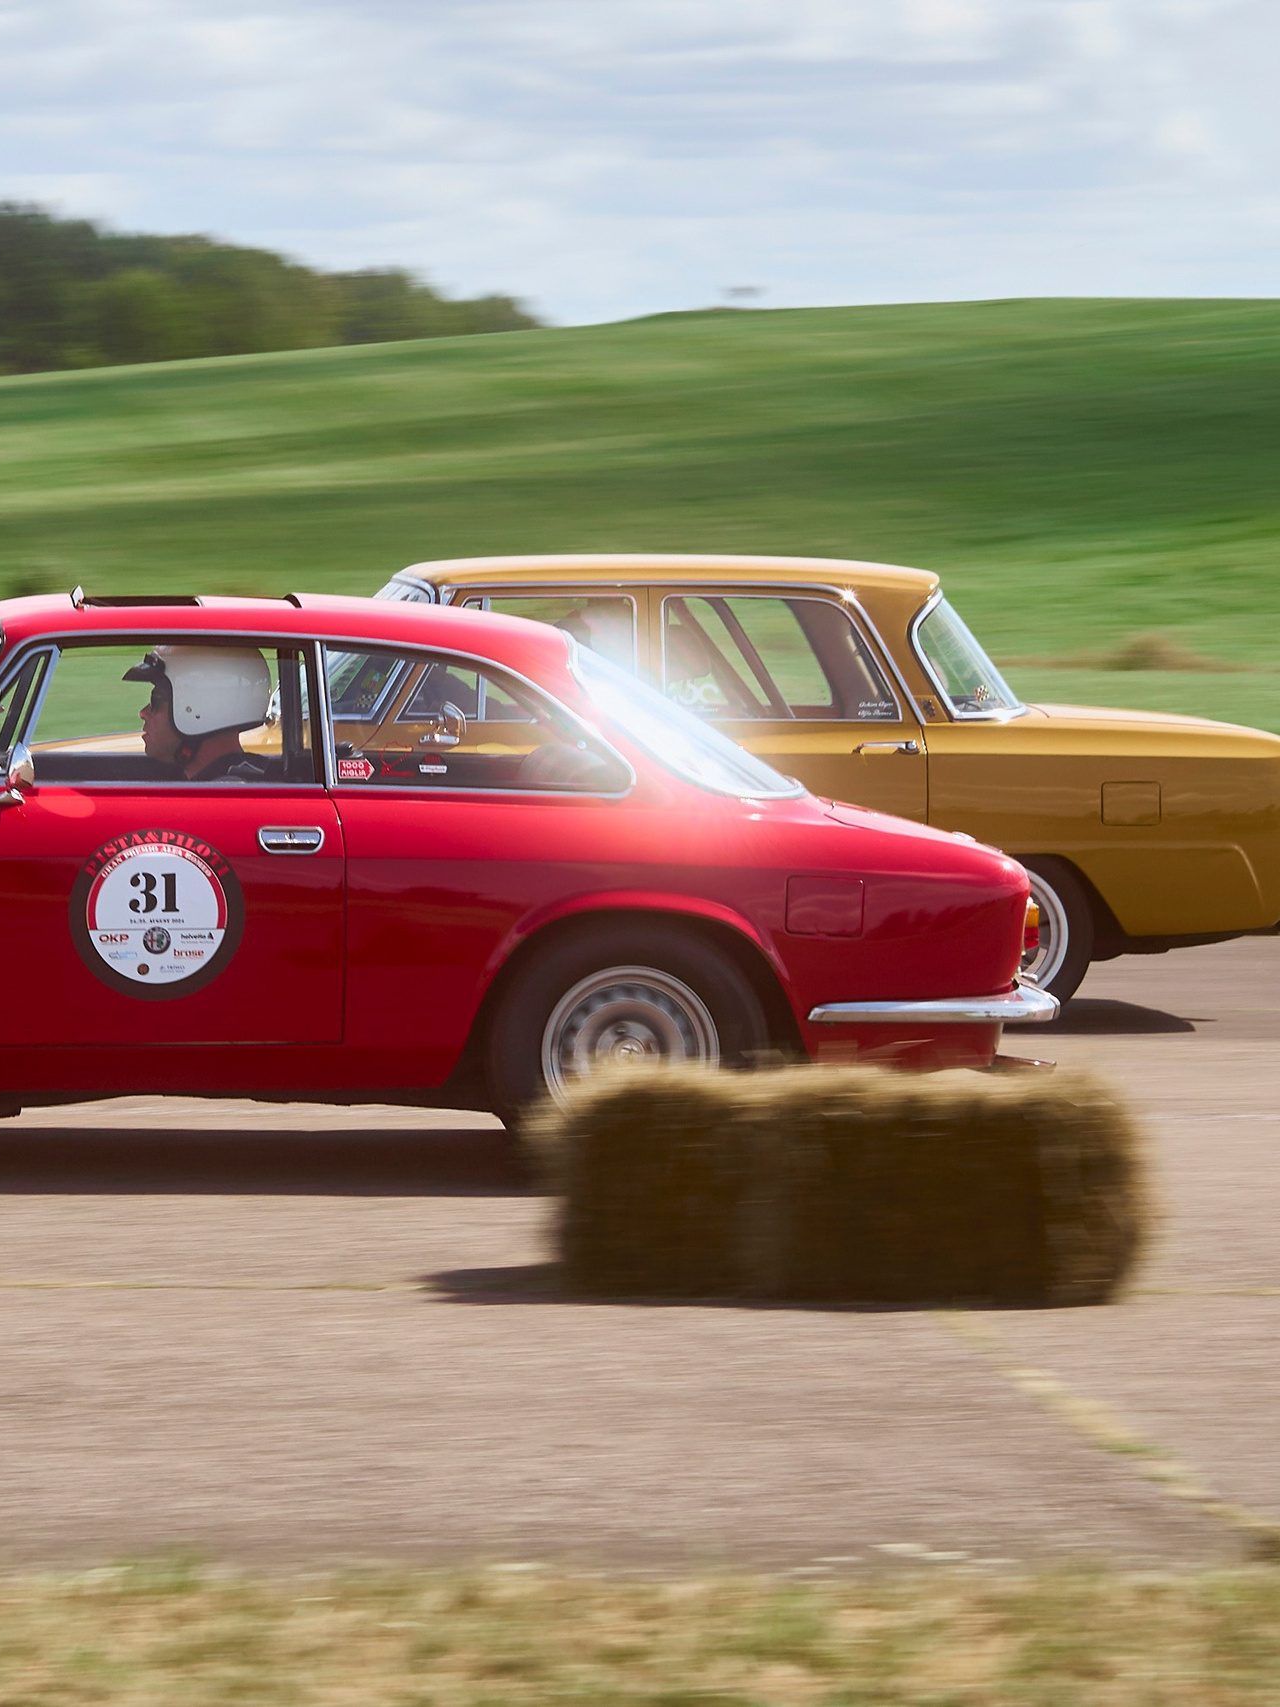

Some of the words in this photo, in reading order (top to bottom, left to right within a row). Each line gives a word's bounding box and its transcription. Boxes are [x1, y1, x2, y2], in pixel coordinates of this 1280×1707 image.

[341, 769, 367, 777] MIGLIA
[84, 831, 231, 878] PISTA&PILOTI
[101, 855, 123, 878] GRAN
[123, 845, 159, 861] PREMIO
[161, 845, 182, 857] ALFA
[184, 852, 213, 877] ROMEO
[128, 872, 180, 913] 31
[99, 933, 130, 943] OKP
[173, 948, 205, 957] brose
